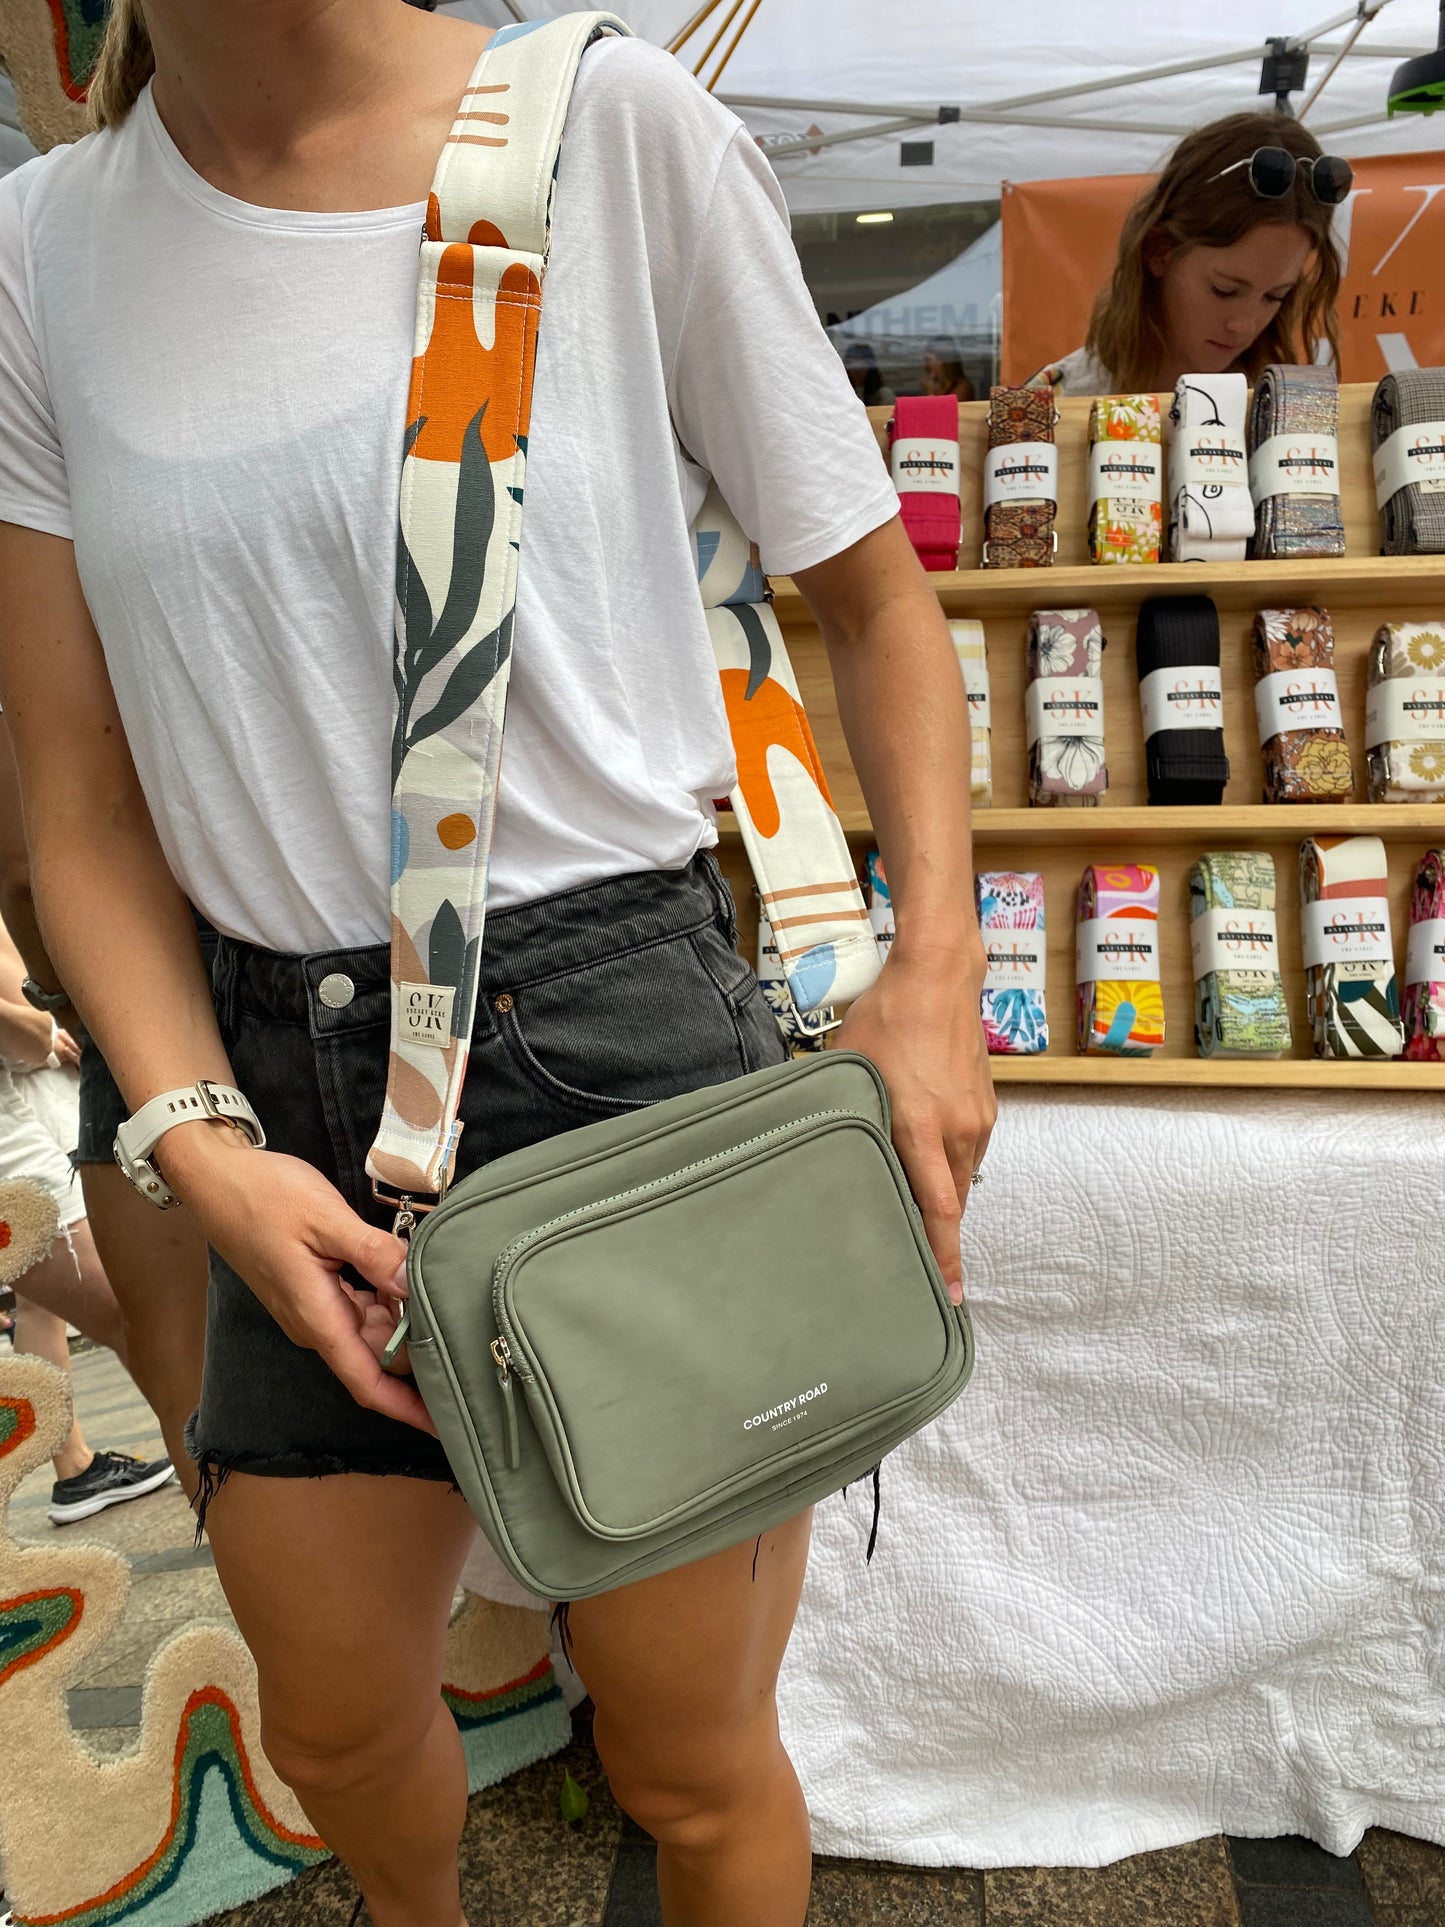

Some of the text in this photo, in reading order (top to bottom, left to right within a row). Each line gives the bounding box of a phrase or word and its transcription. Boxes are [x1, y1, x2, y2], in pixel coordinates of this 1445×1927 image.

[1352, 290, 1425, 319] EKE
[906, 450, 948, 478] SK
[1198, 437, 1240, 466] SK
[1286, 447, 1330, 476] SK
[1000, 455, 1044, 484] SK
[1107, 453, 1149, 483] SK
[1050, 690, 1094, 719] SK
[1174, 679, 1218, 710] SK
[1286, 681, 1333, 712] SK
[1225, 920, 1269, 951] SK
[1331, 912, 1381, 944] SK
[1105, 932, 1147, 962] SK
[409, 992, 444, 1030] SK
[743, 1382, 828, 1430] COUNTRY ROAD
[771, 1410, 808, 1432] SINCE 1974
